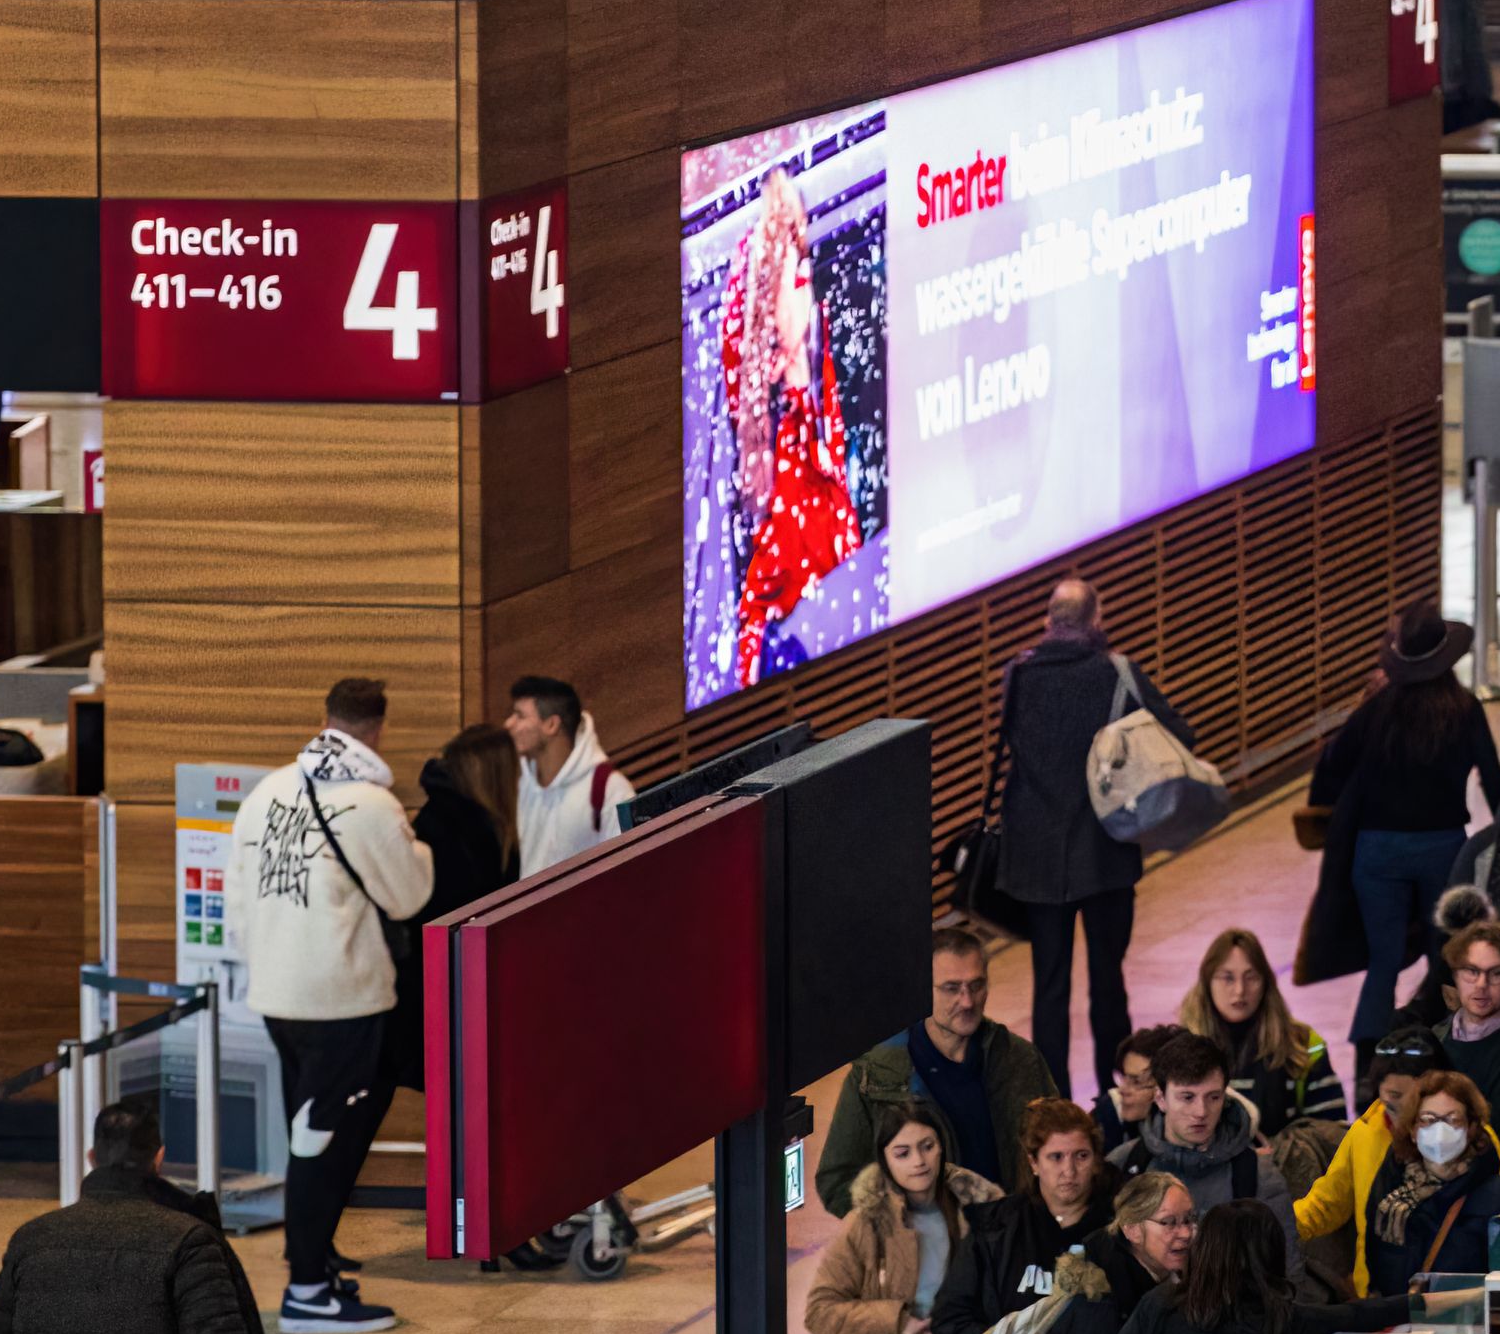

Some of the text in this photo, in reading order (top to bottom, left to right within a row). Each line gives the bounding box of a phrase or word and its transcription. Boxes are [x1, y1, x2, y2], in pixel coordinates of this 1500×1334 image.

[131, 217, 298, 257] Check-in
[917, 149, 1007, 228] Smarter
[1091, 169, 1252, 280] Supercomputer
[343, 223, 438, 360] 4
[531, 205, 565, 339] 4
[916, 343, 1051, 441] von Lenovo
